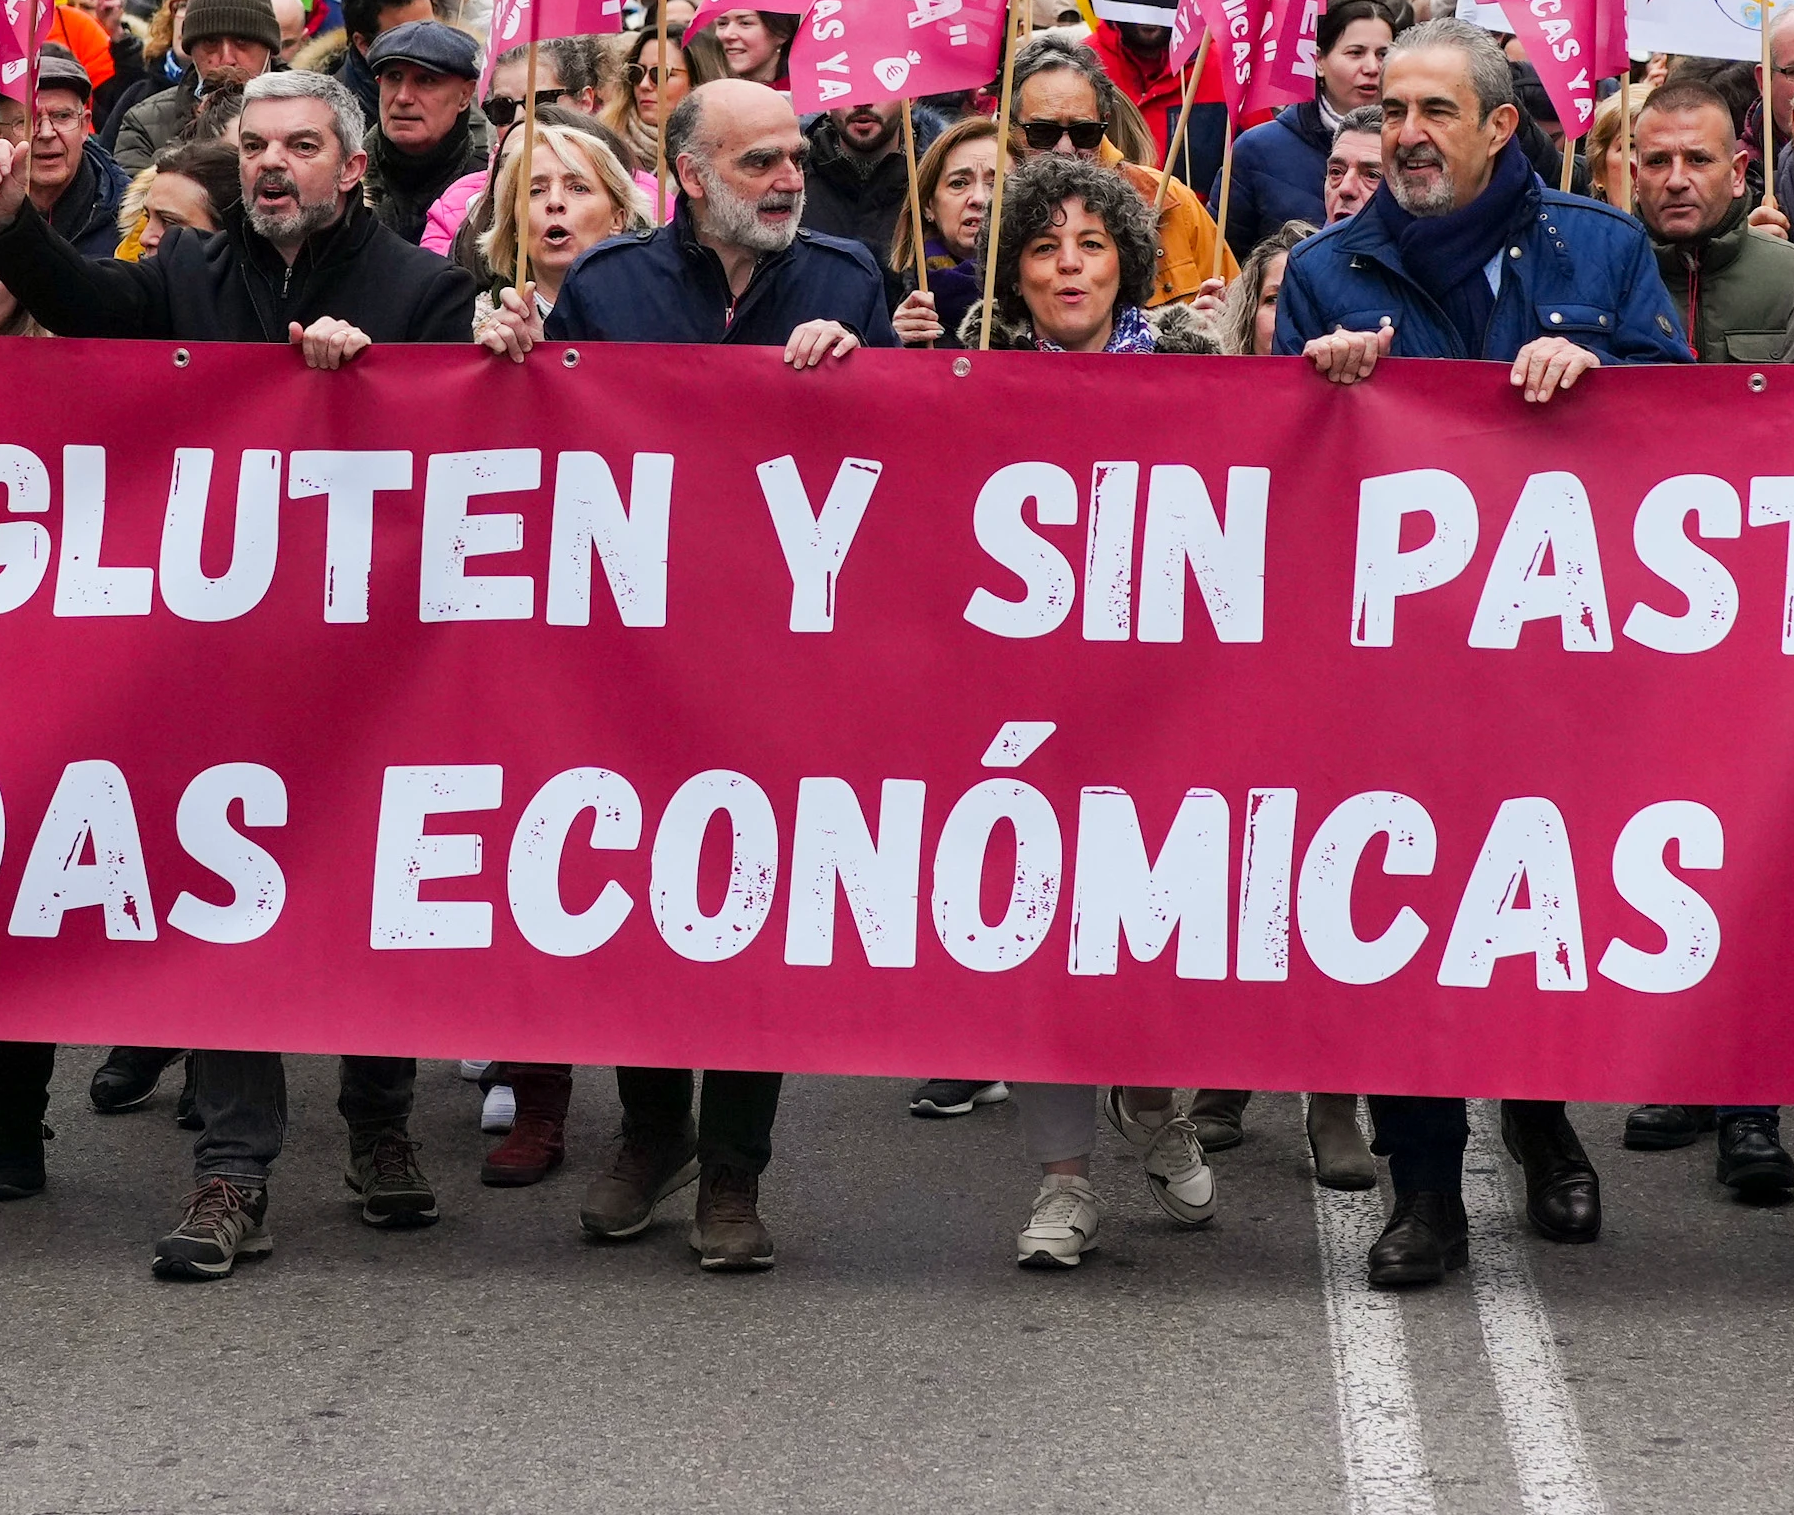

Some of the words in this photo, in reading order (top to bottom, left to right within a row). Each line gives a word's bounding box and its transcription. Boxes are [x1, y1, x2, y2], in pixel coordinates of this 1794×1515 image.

[756, 455, 882, 632] Y
[964, 461, 1270, 642] SIN
[370, 722, 1723, 993] ECONÓMICAS
